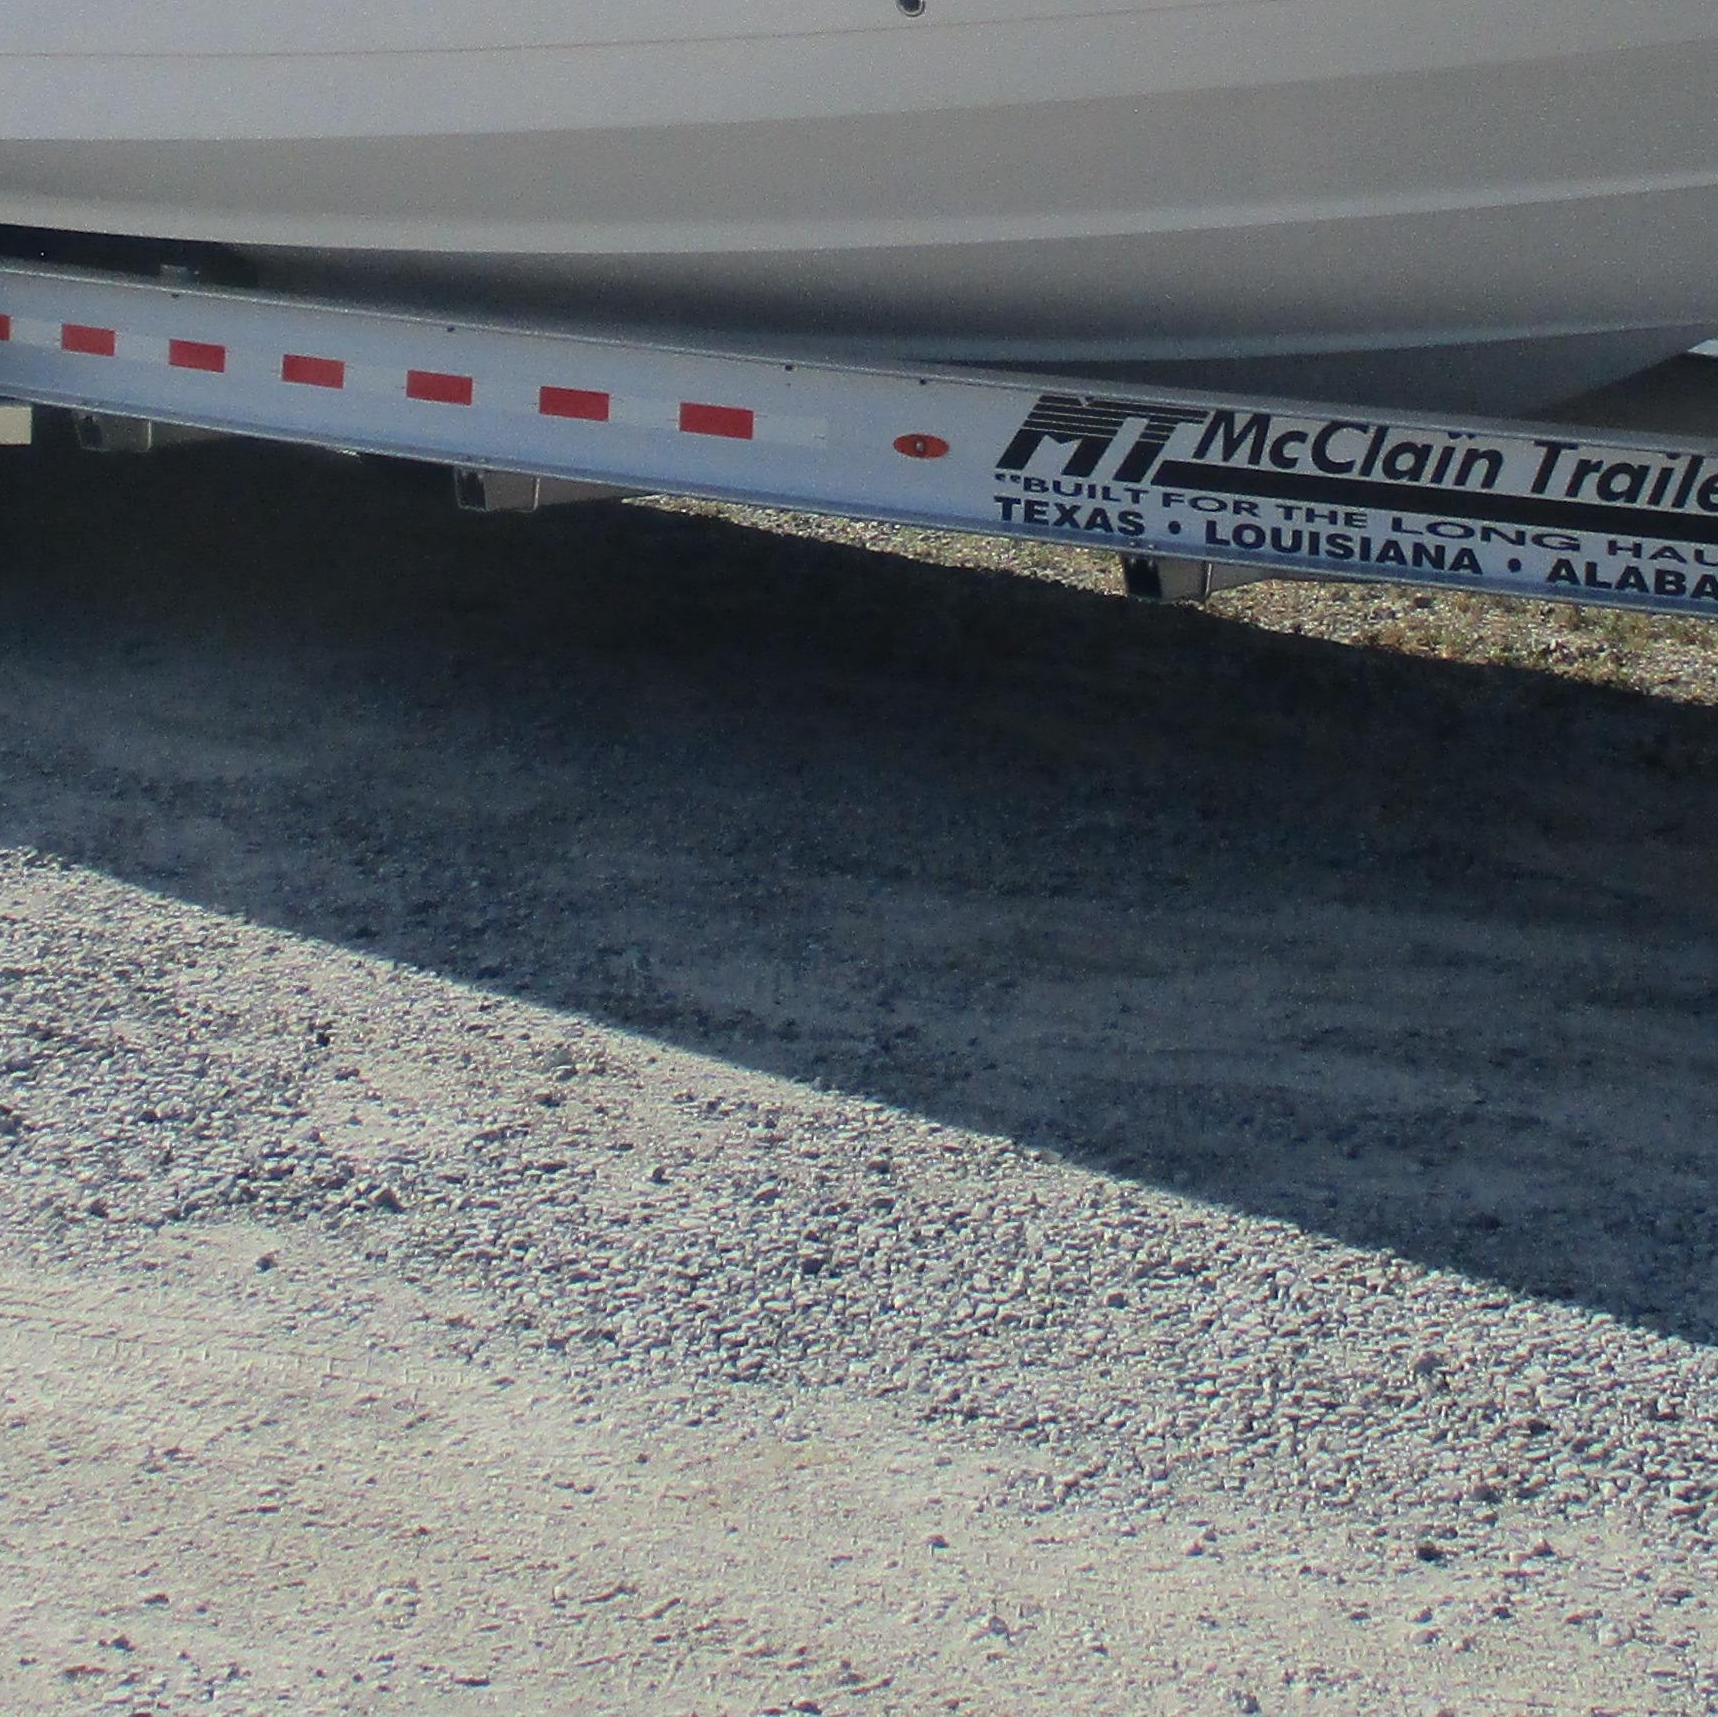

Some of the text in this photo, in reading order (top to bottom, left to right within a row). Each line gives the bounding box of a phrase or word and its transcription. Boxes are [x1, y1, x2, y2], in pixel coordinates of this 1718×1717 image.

[1191, 409, 1504, 489] McClain
[994, 495, 1146, 536] TEXAS
[1205, 519, 1483, 574] LOUISIANA
[1162, 492, 1261, 517] FOR
[1276, 504, 1368, 529] THE
[1392, 517, 1581, 552] LONG
